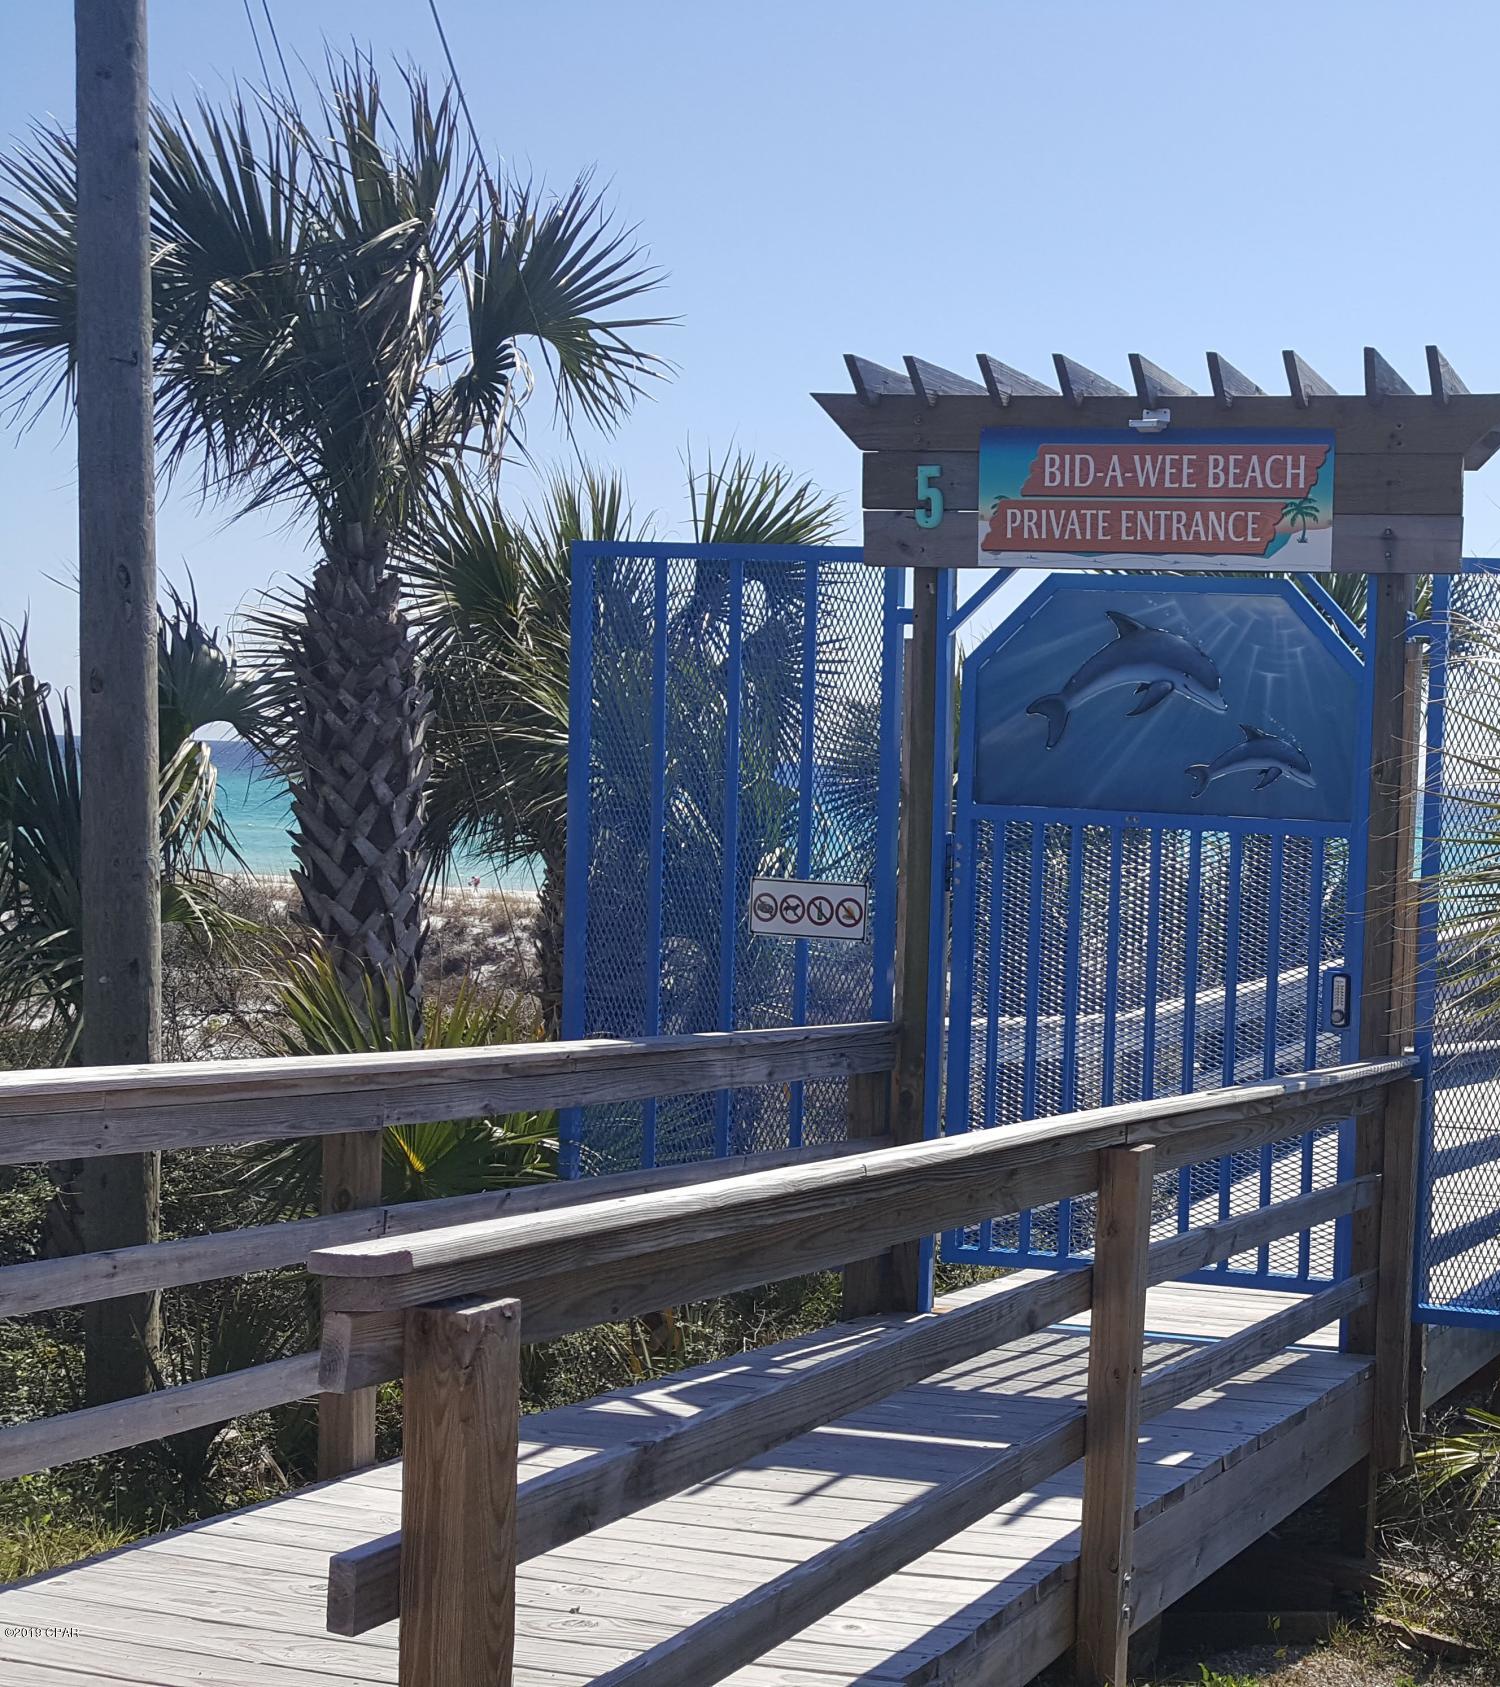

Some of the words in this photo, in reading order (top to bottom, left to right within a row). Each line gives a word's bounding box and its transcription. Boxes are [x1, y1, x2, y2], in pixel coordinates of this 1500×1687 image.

[1043, 453, 1197, 489] BID-A-WEE
[1207, 453, 1306, 489] BEACH
[915, 465, 944, 529] 5
[1006, 508, 1111, 540] PRIVATE
[1120, 510, 1261, 542] ENTRANCE
